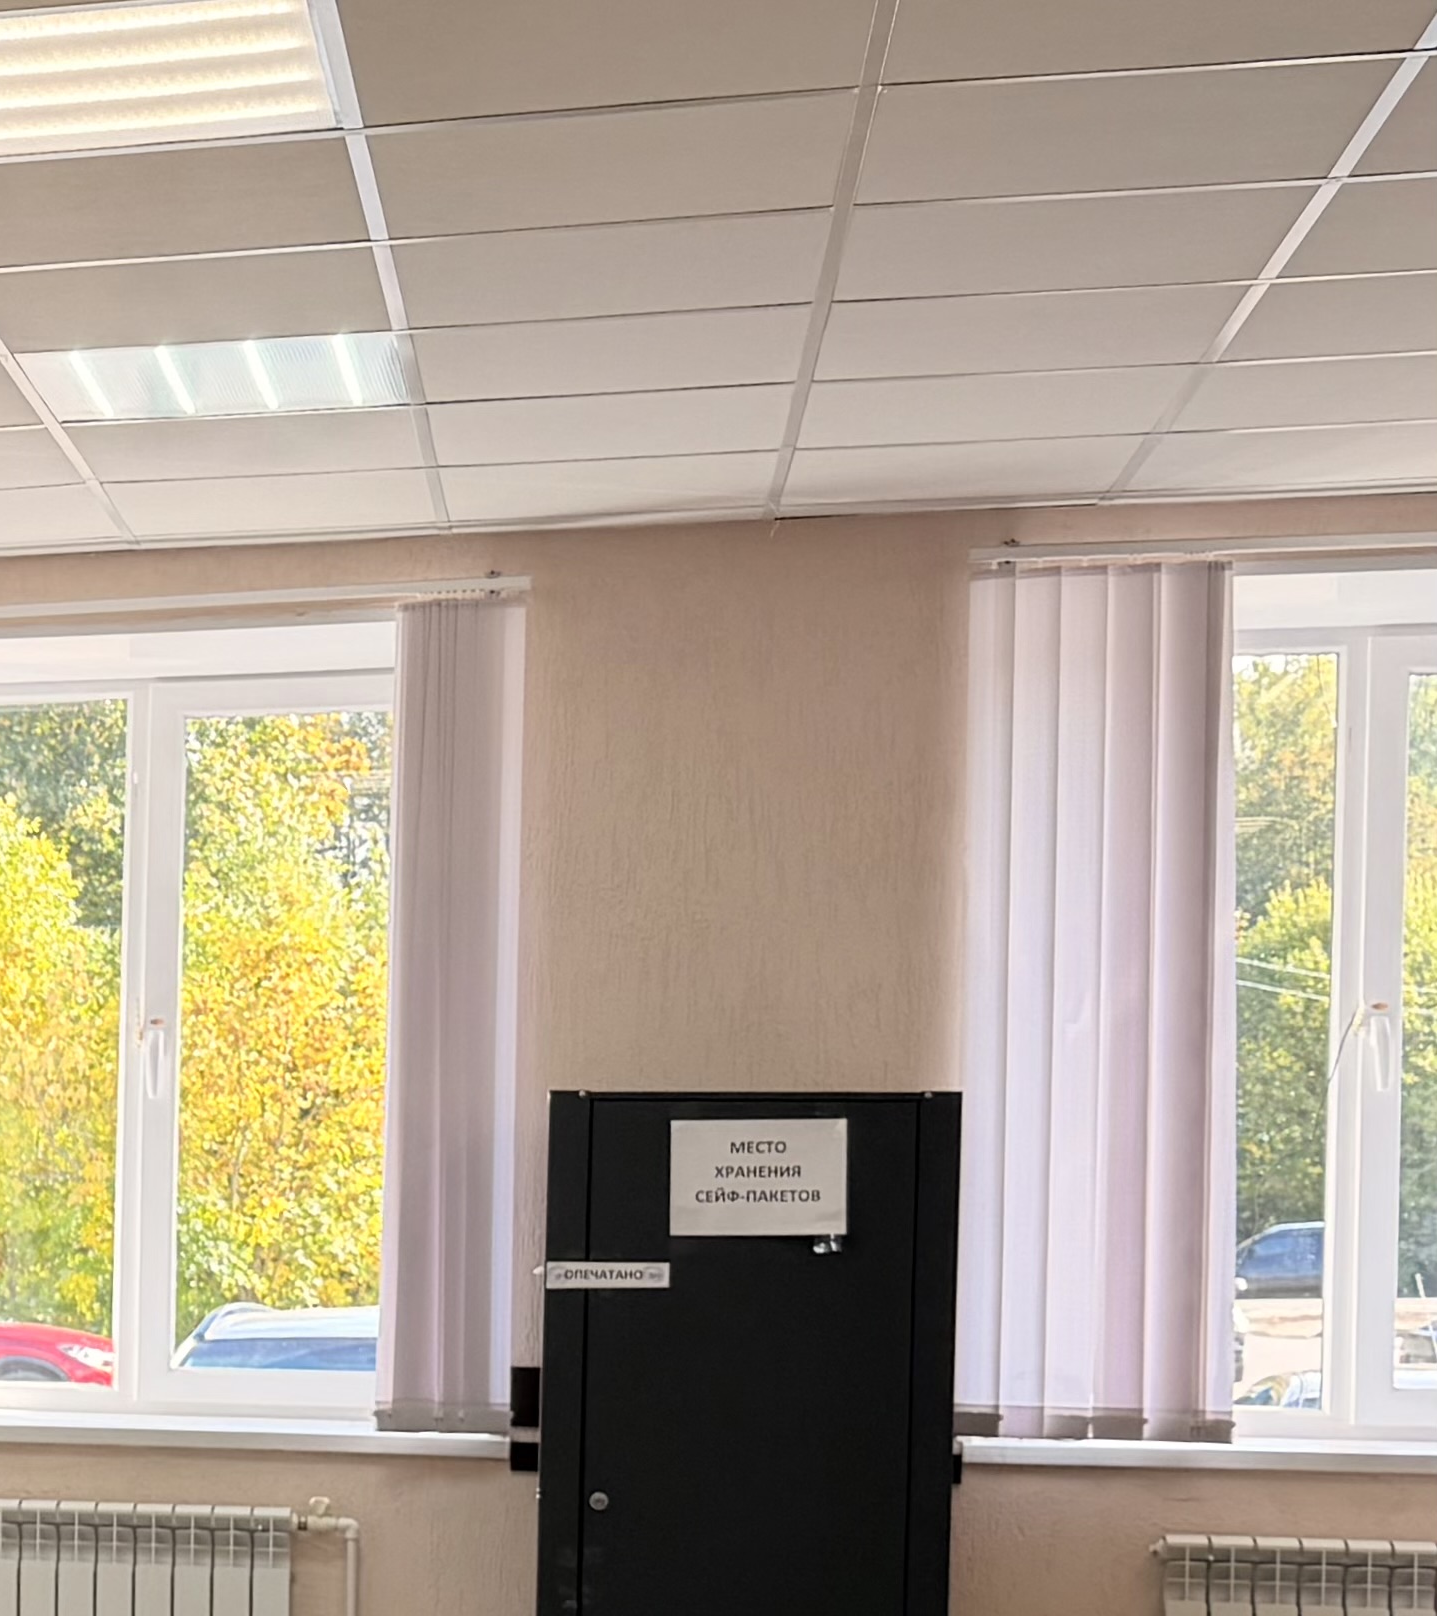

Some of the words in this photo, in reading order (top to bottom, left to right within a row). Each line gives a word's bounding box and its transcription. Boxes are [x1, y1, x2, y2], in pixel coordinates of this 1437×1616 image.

[729, 1140, 787, 1155] МЕСТО
[714, 1165, 802, 1179] ХРАНЕНИЯ
[694, 1187, 822, 1204] СЕЙФ-ПАКЕТОВ
[563, 1268, 645, 1281] ОПЕЧАТАНО
